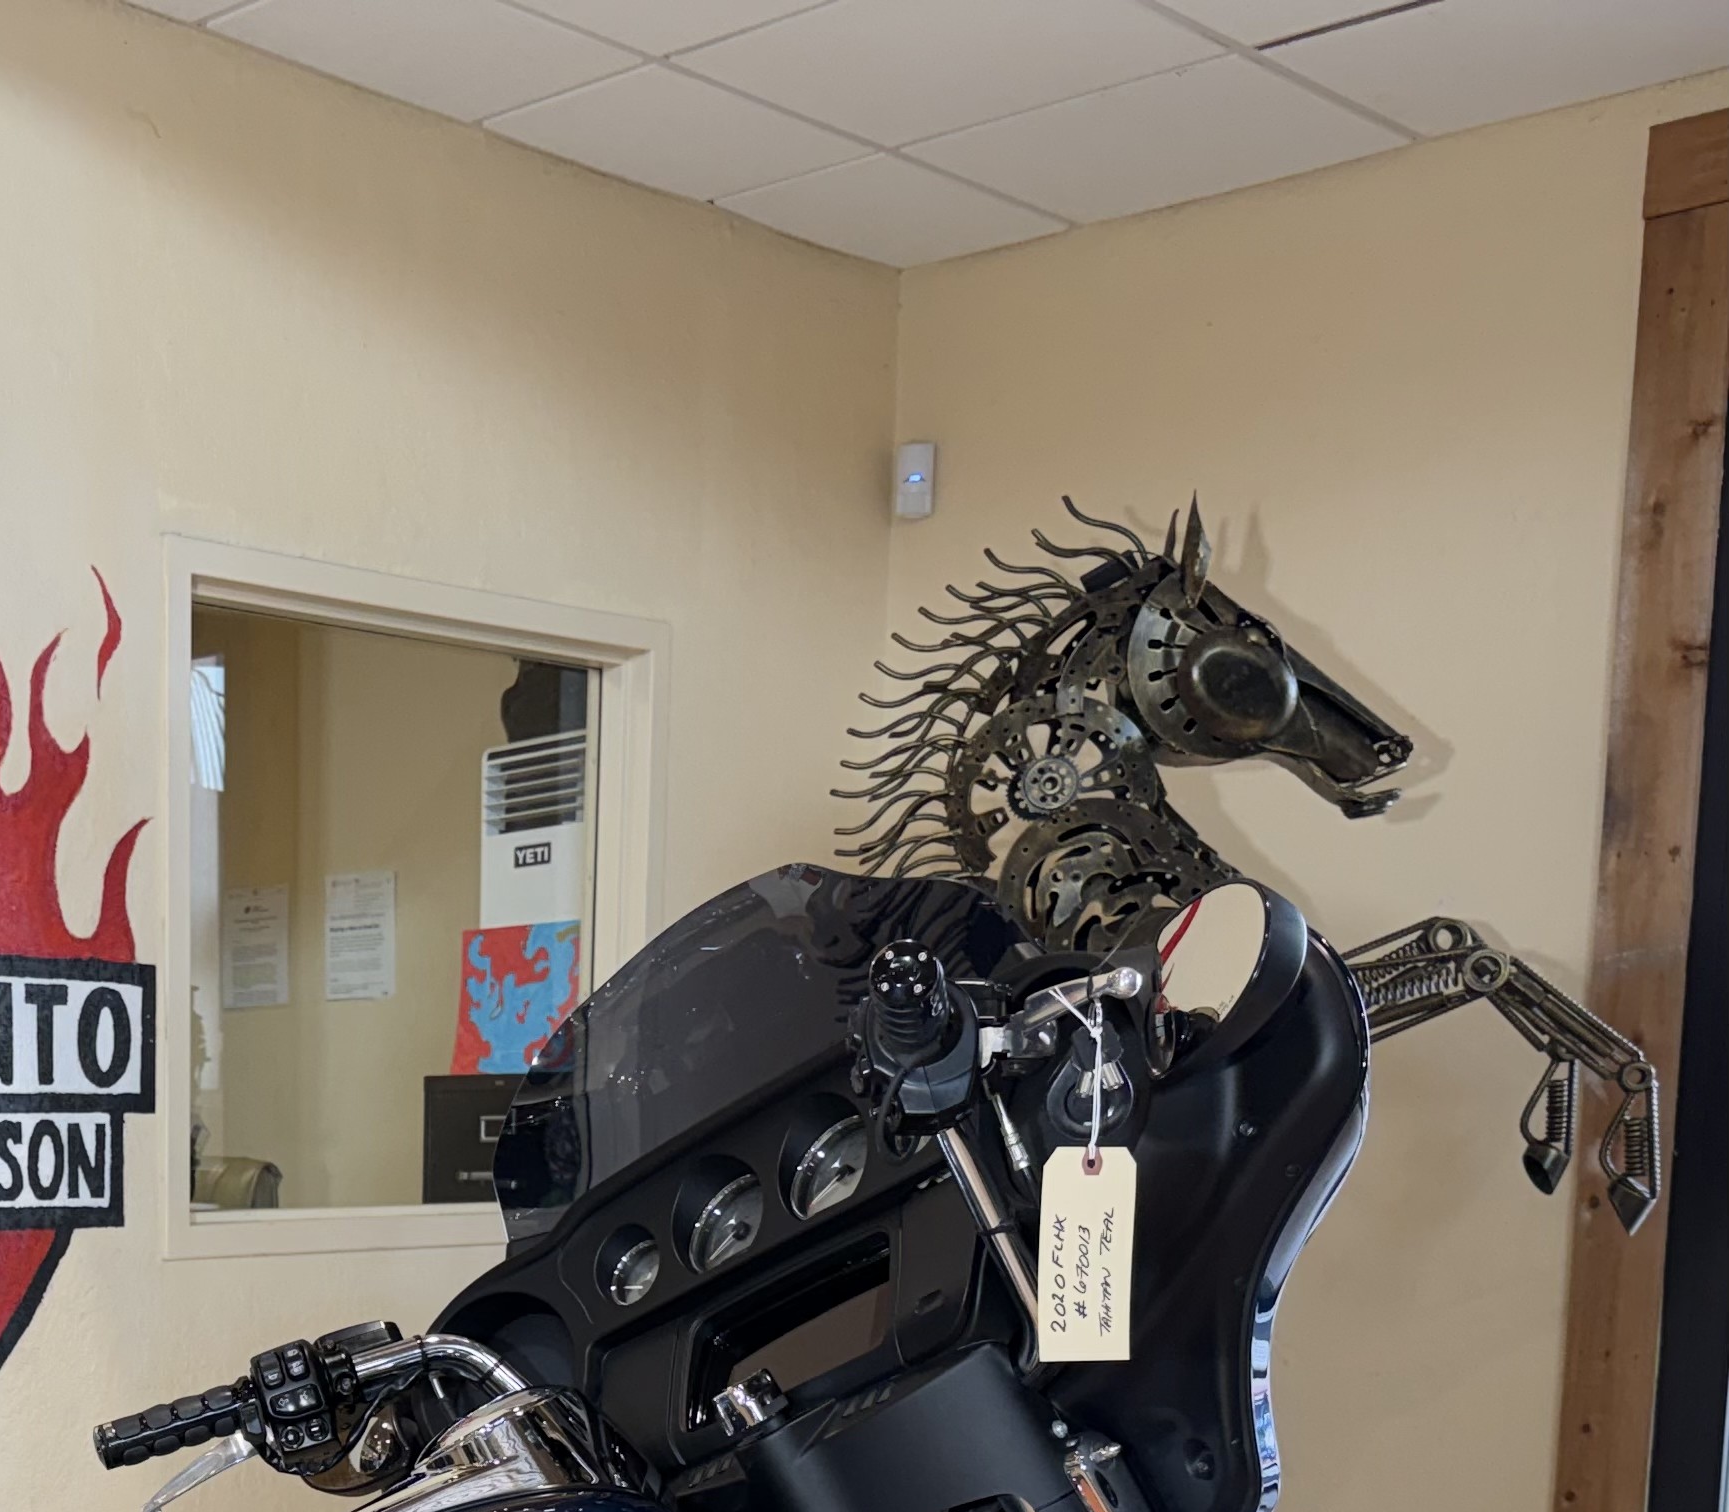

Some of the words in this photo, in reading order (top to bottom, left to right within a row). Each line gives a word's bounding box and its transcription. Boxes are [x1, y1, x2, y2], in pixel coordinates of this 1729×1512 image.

[515, 846, 550, 865] YETI
[1051, 1213, 1067, 1269] FLHX
[1099, 1207, 1114, 1256] TEAL
[1050, 1273, 1067, 1333] 2020
